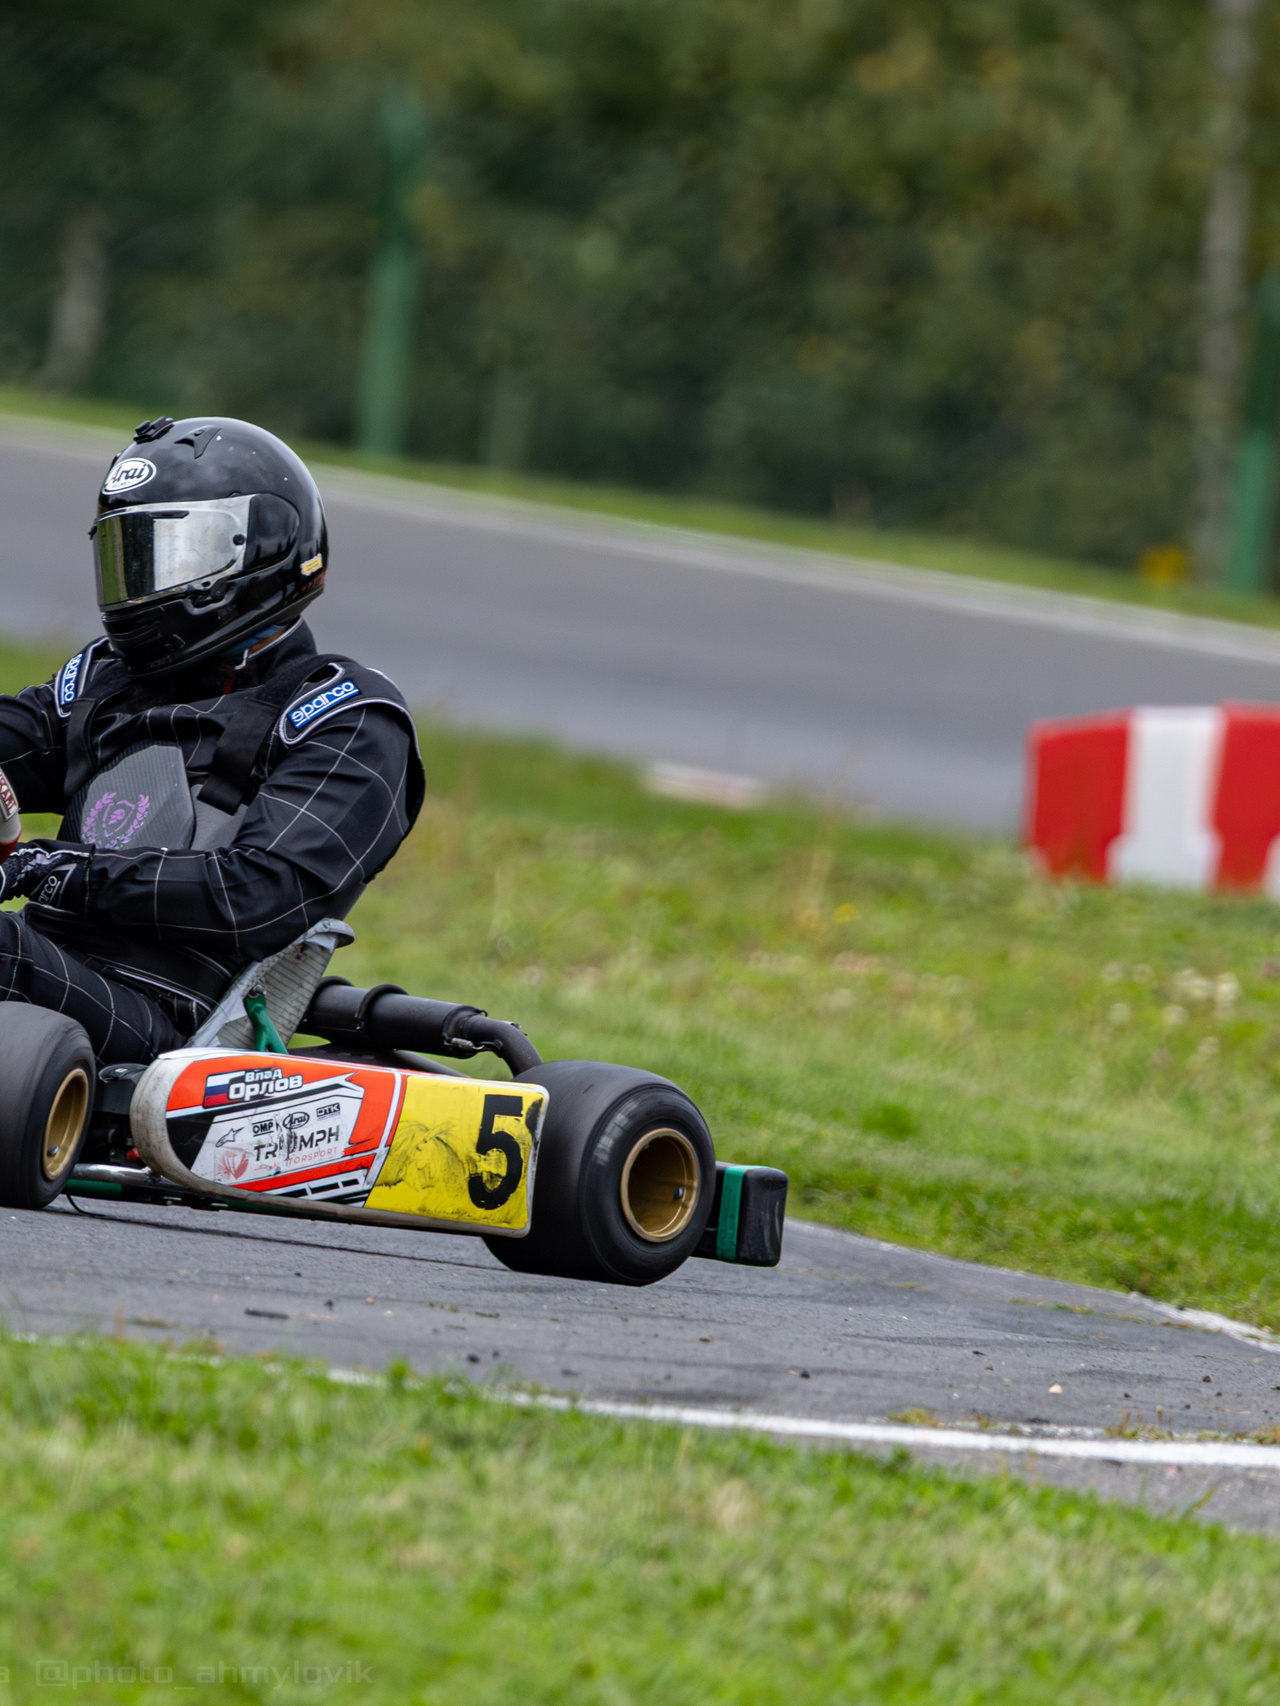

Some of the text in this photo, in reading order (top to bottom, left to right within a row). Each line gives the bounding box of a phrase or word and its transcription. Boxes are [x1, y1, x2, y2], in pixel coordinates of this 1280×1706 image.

[110, 463, 147, 484] Arai
[291, 682, 355, 722] sparco
[228, 1075, 303, 1101] Орлов
[252, 1121, 274, 1134] OMP
[467, 1094, 524, 1210] 5
